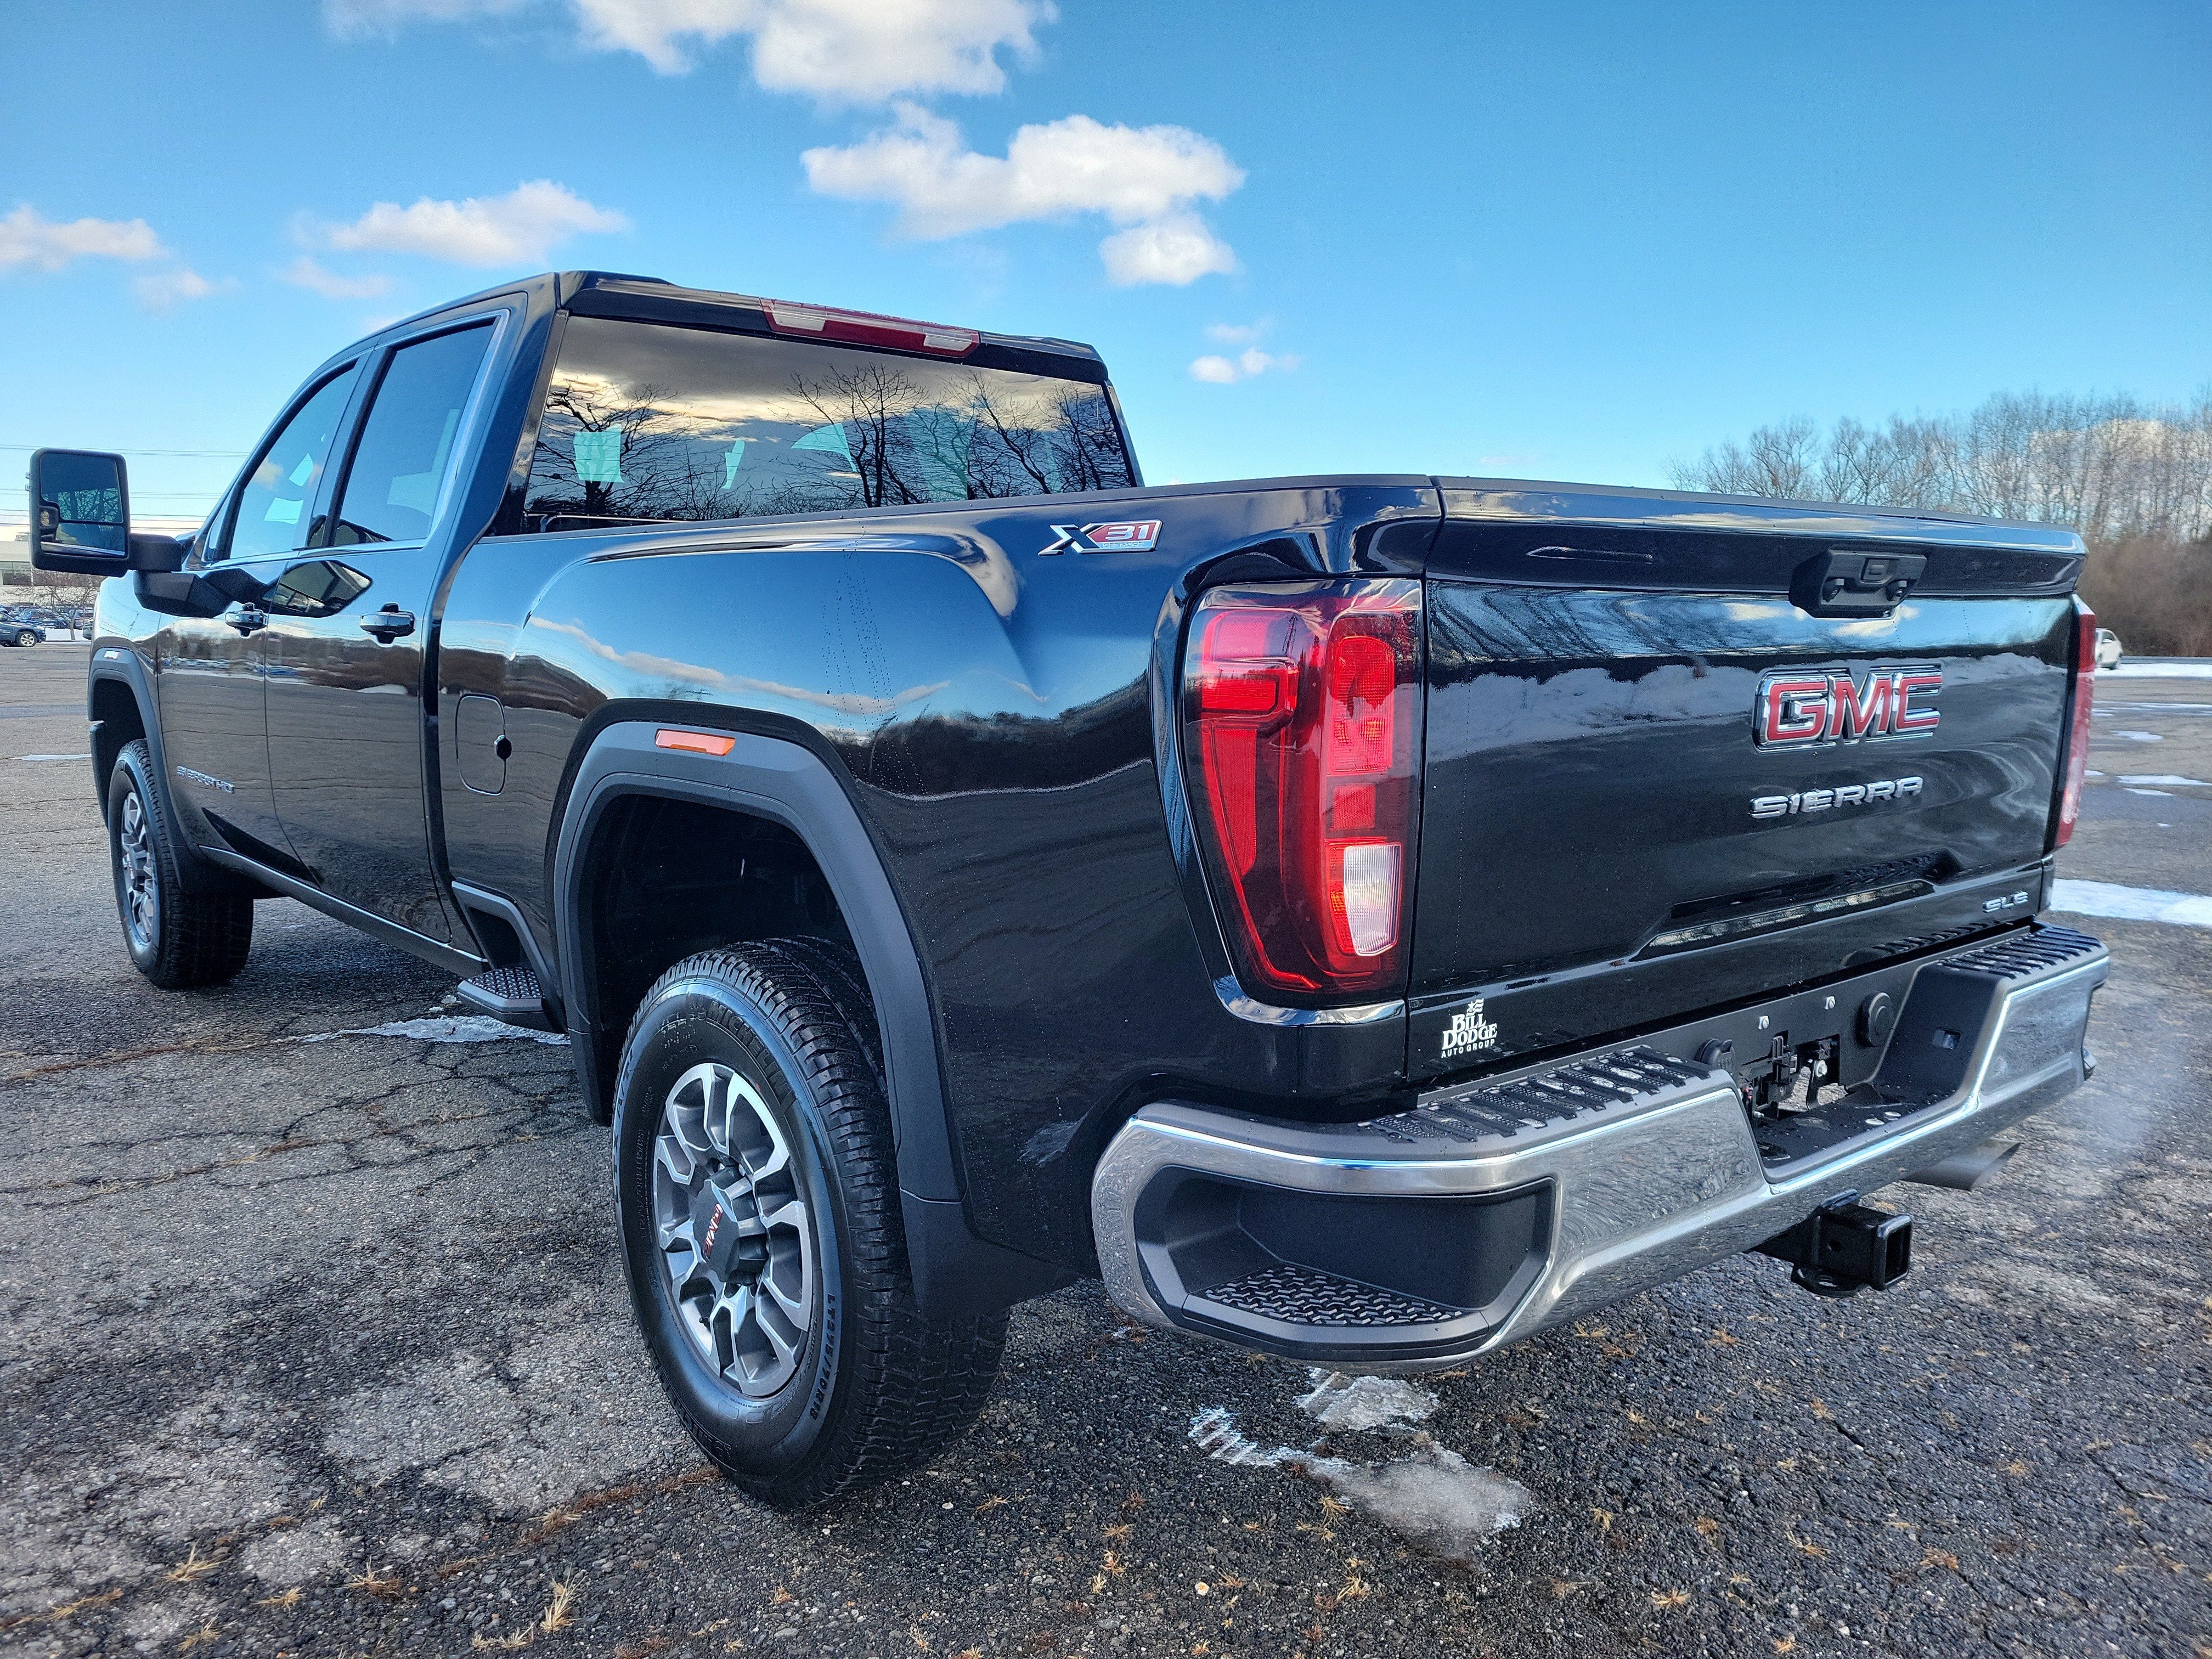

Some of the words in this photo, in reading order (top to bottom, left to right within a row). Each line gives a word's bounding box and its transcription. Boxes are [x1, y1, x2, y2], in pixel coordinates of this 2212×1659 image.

[1753, 664, 1943, 754] GMC
[1748, 776, 1923, 819] SIERRA
[1442, 1023, 1497, 1050] DODGE
[1452, 1013, 1486, 1032] BILL
[707, 1001, 794, 1095] MICHELIN
[1441, 1046, 1464, 1058] AUTO
[1466, 1039, 1495, 1052] GROUP
[703, 1203, 723, 1261] GMC
[810, 1293, 836, 1420] LT275/70R18
